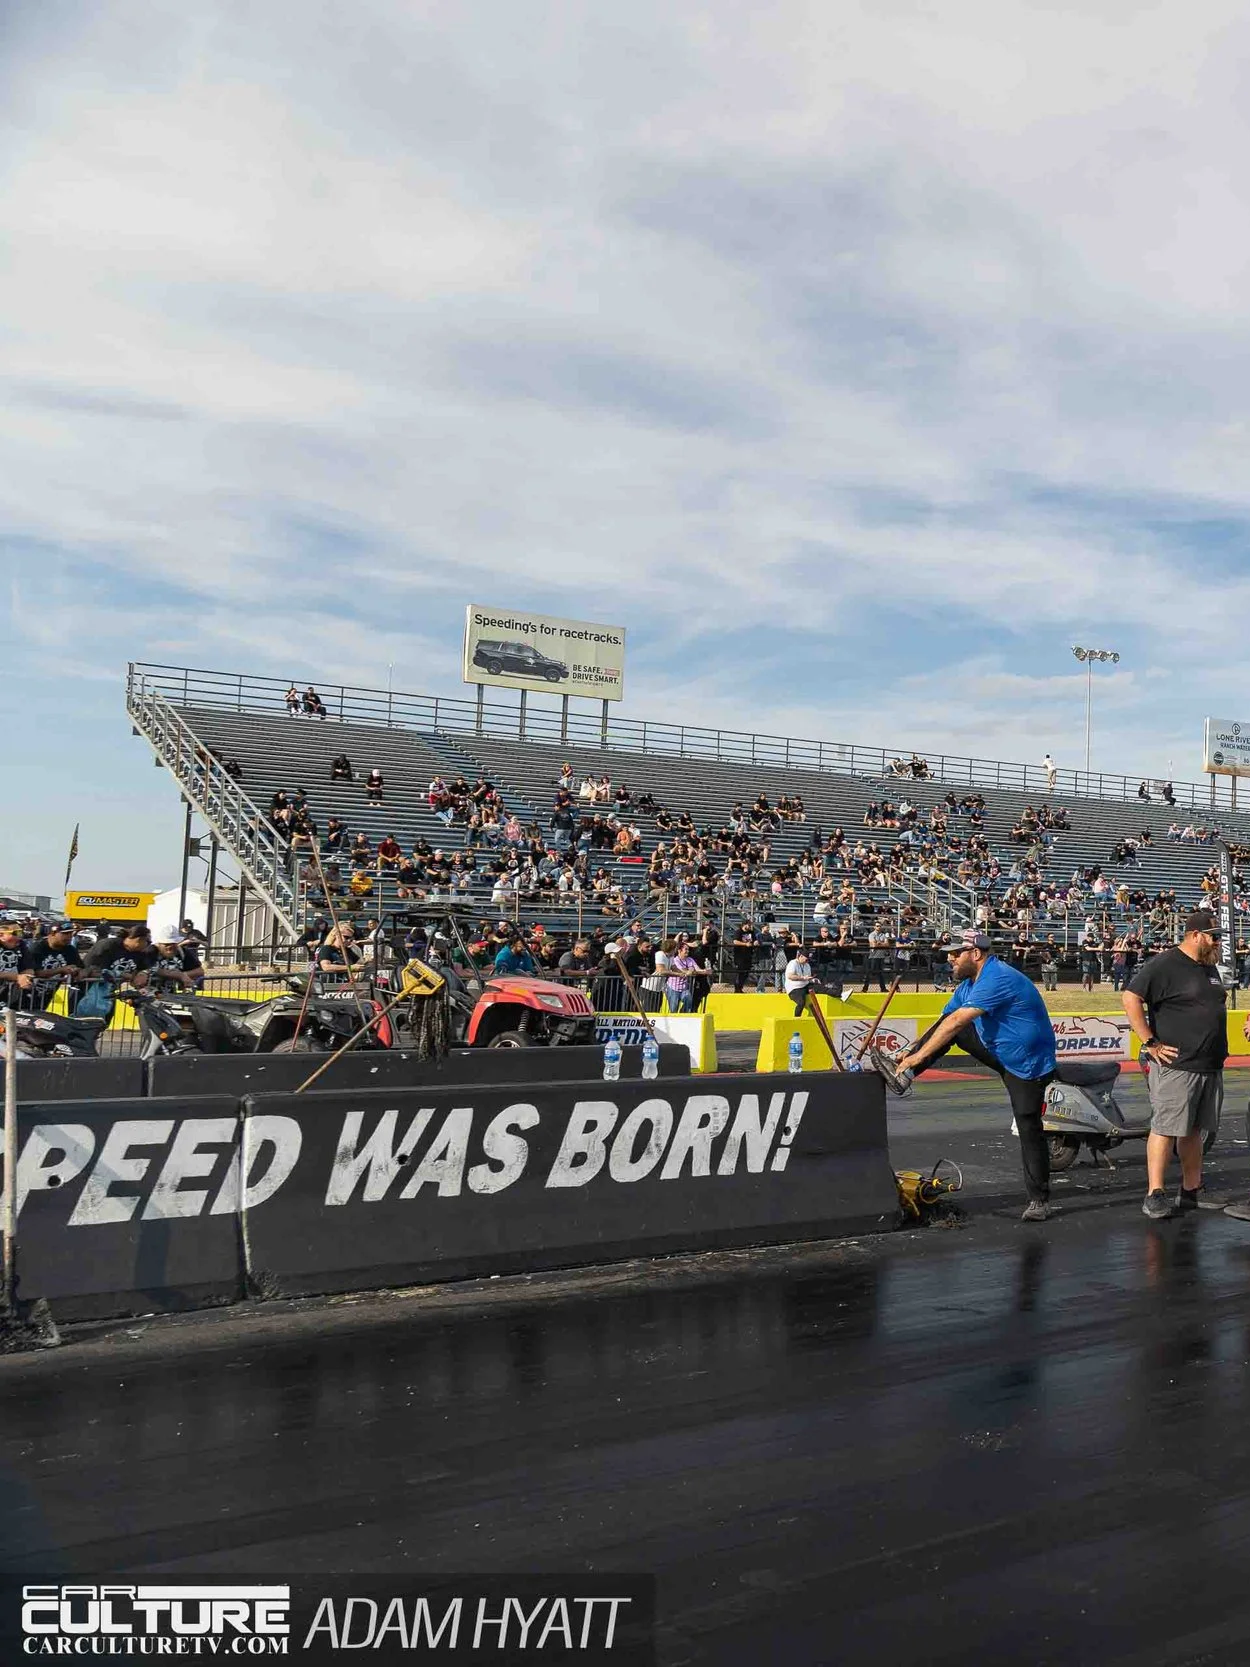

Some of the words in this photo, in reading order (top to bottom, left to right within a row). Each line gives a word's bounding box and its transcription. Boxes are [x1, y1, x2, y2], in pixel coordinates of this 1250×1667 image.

[475, 613, 537, 634] Speeding's
[540, 623, 556, 636] for
[559, 629, 622, 645] racetracks.
[572, 672, 594, 681] DRIVE
[1216, 734, 1234, 743] LONE
[612, 1018, 656, 1028] NATIONAS
[1056, 1036, 1122, 1051] ORPLEX
[0, 1115, 302, 1231] PEED
[325, 1103, 540, 1206] WAS
[544, 1091, 810, 1190] BORN!
